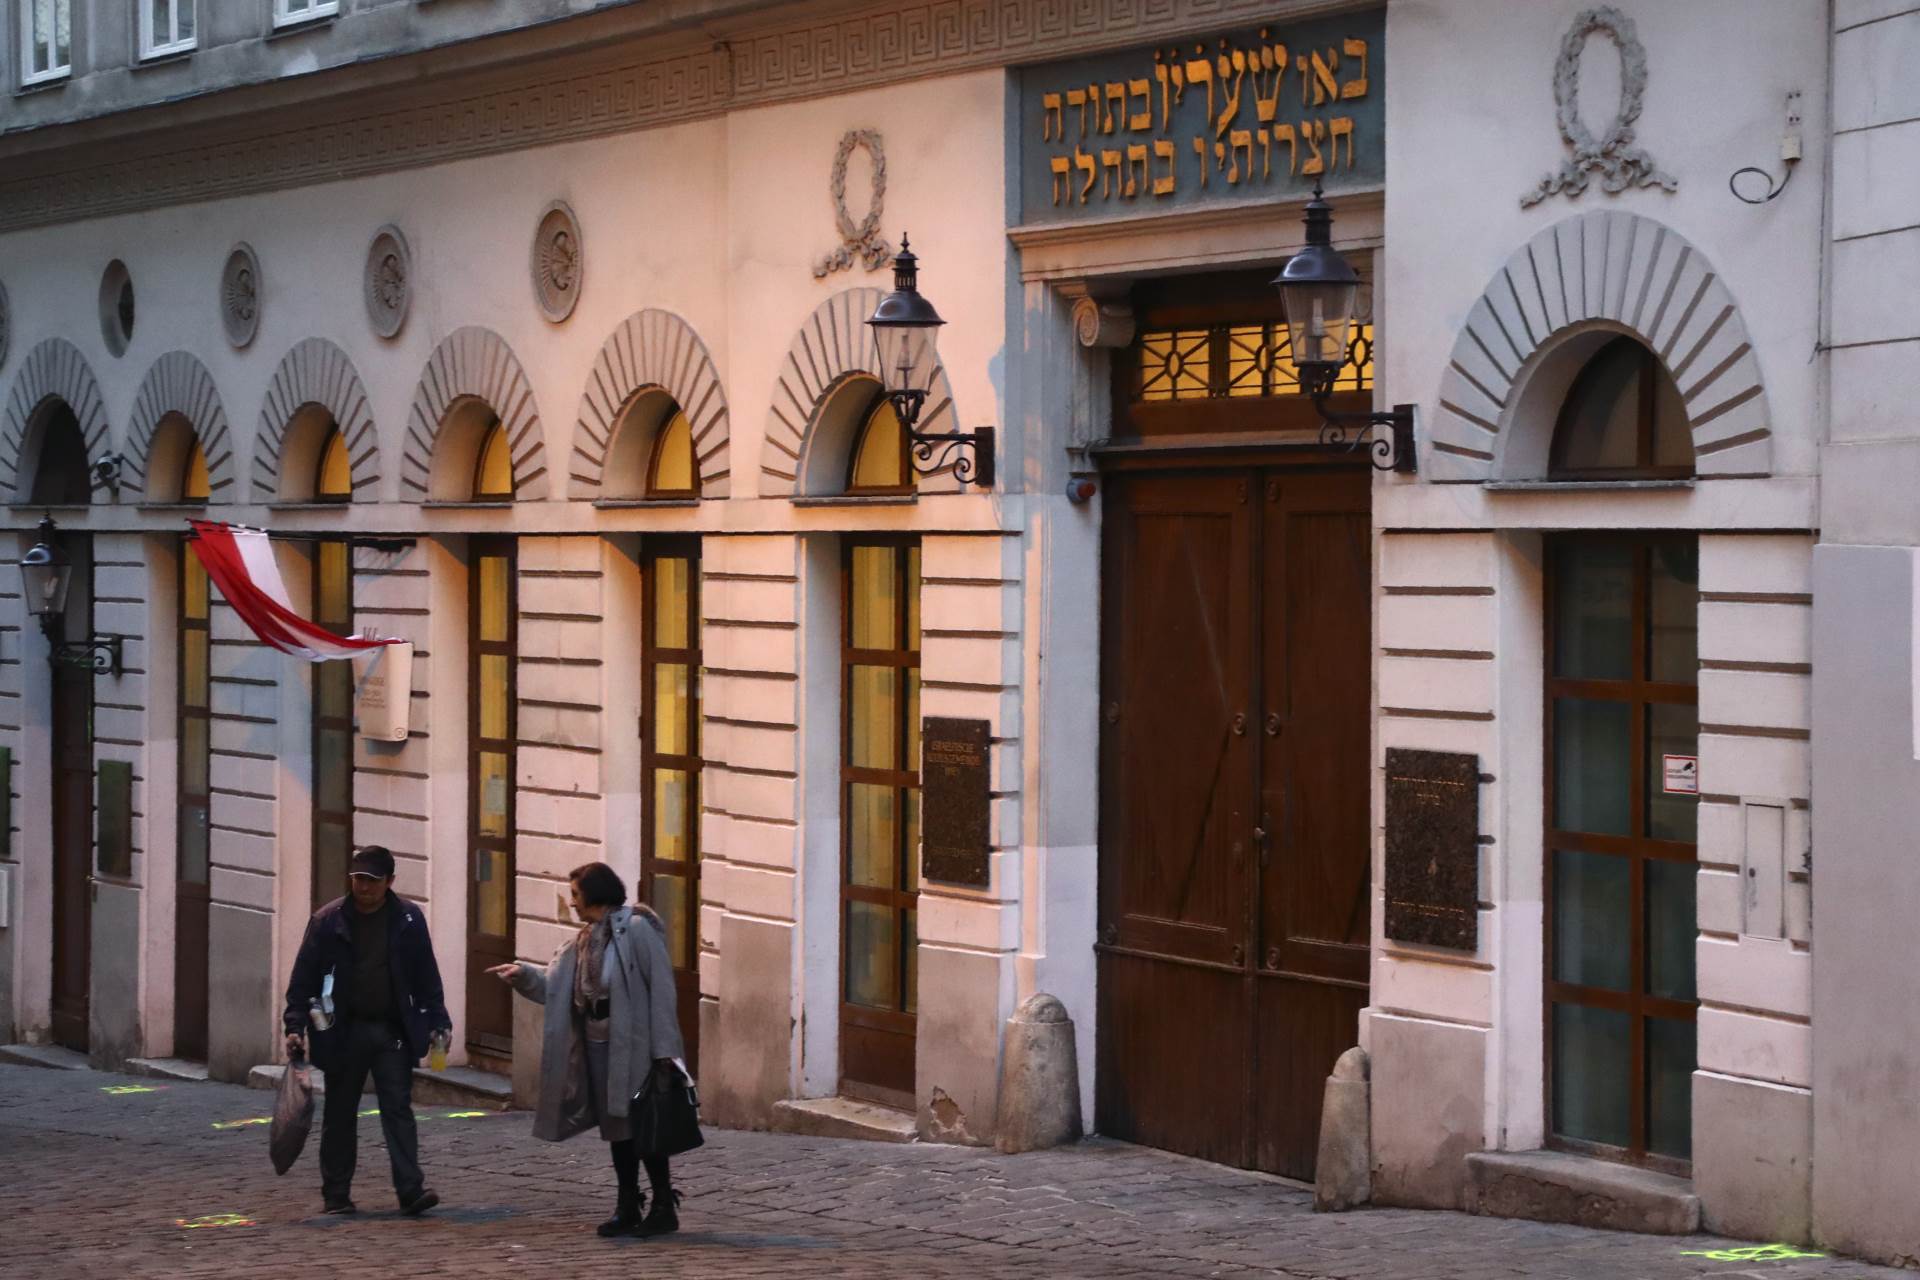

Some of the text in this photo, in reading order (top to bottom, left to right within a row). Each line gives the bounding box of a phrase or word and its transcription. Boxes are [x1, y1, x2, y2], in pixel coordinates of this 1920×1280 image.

[1297, 37, 1368, 107] באו
[1043, 79, 1152, 142] בתודה
[1051, 117, 1354, 205] חצרותיו בתהלה
